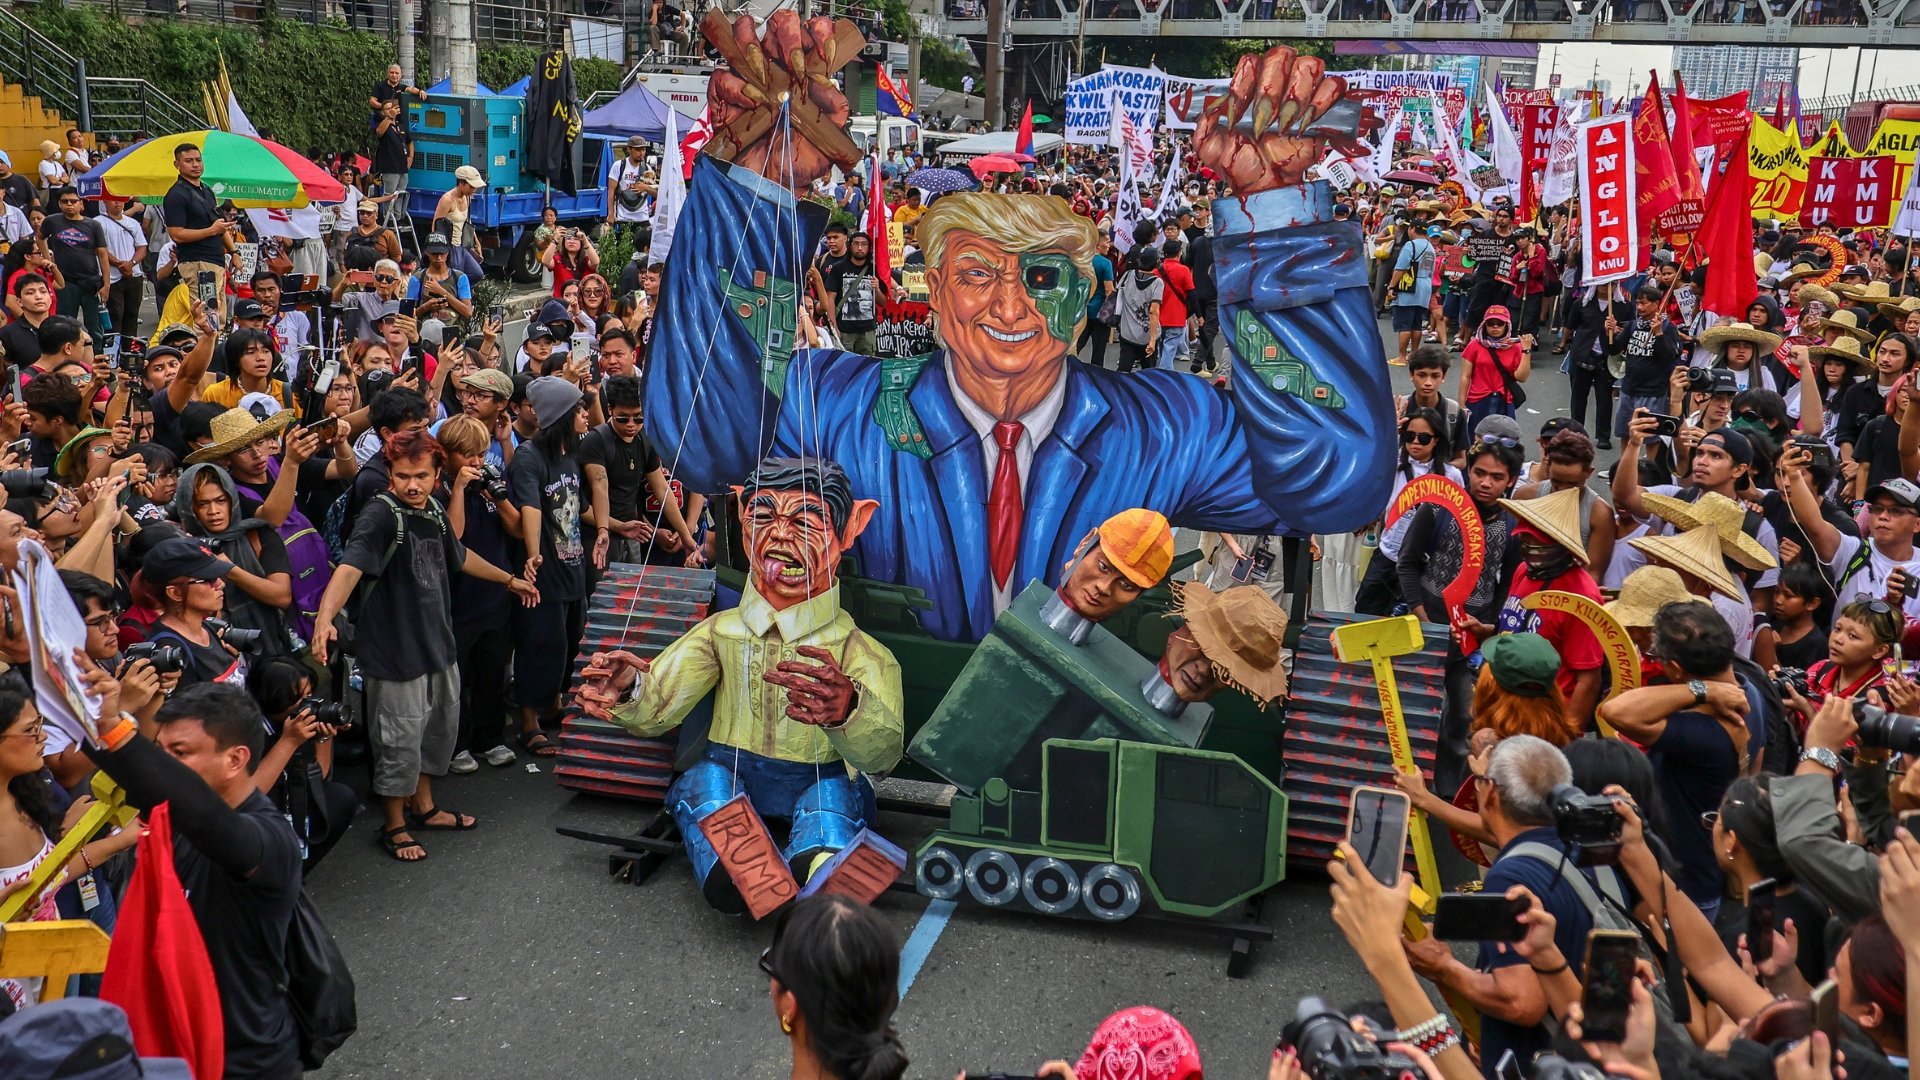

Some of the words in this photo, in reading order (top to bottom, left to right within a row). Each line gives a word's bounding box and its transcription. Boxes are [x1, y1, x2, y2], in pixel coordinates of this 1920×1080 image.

[1764, 73, 1792, 83] HERE
[671, 94, 699, 103] MEDIA
[1331, 164, 1348, 188] BIEN
[228, 185, 289, 197] MICROMATIC
[1595, 127, 1619, 253] ANGLO
[1812, 160, 1839, 226] KMU
[1856, 159, 1879, 225] KMU
[1682, 202, 1698, 212] PAX
[1660, 214, 1688, 229] SILICA
[1599, 257, 1625, 271] KMU
[909, 275, 921, 283] PAX
[1539, 594, 1571, 609] STOP
[1573, 600, 1618, 641] KILLING
[710, 798, 793, 900] TRUMP
